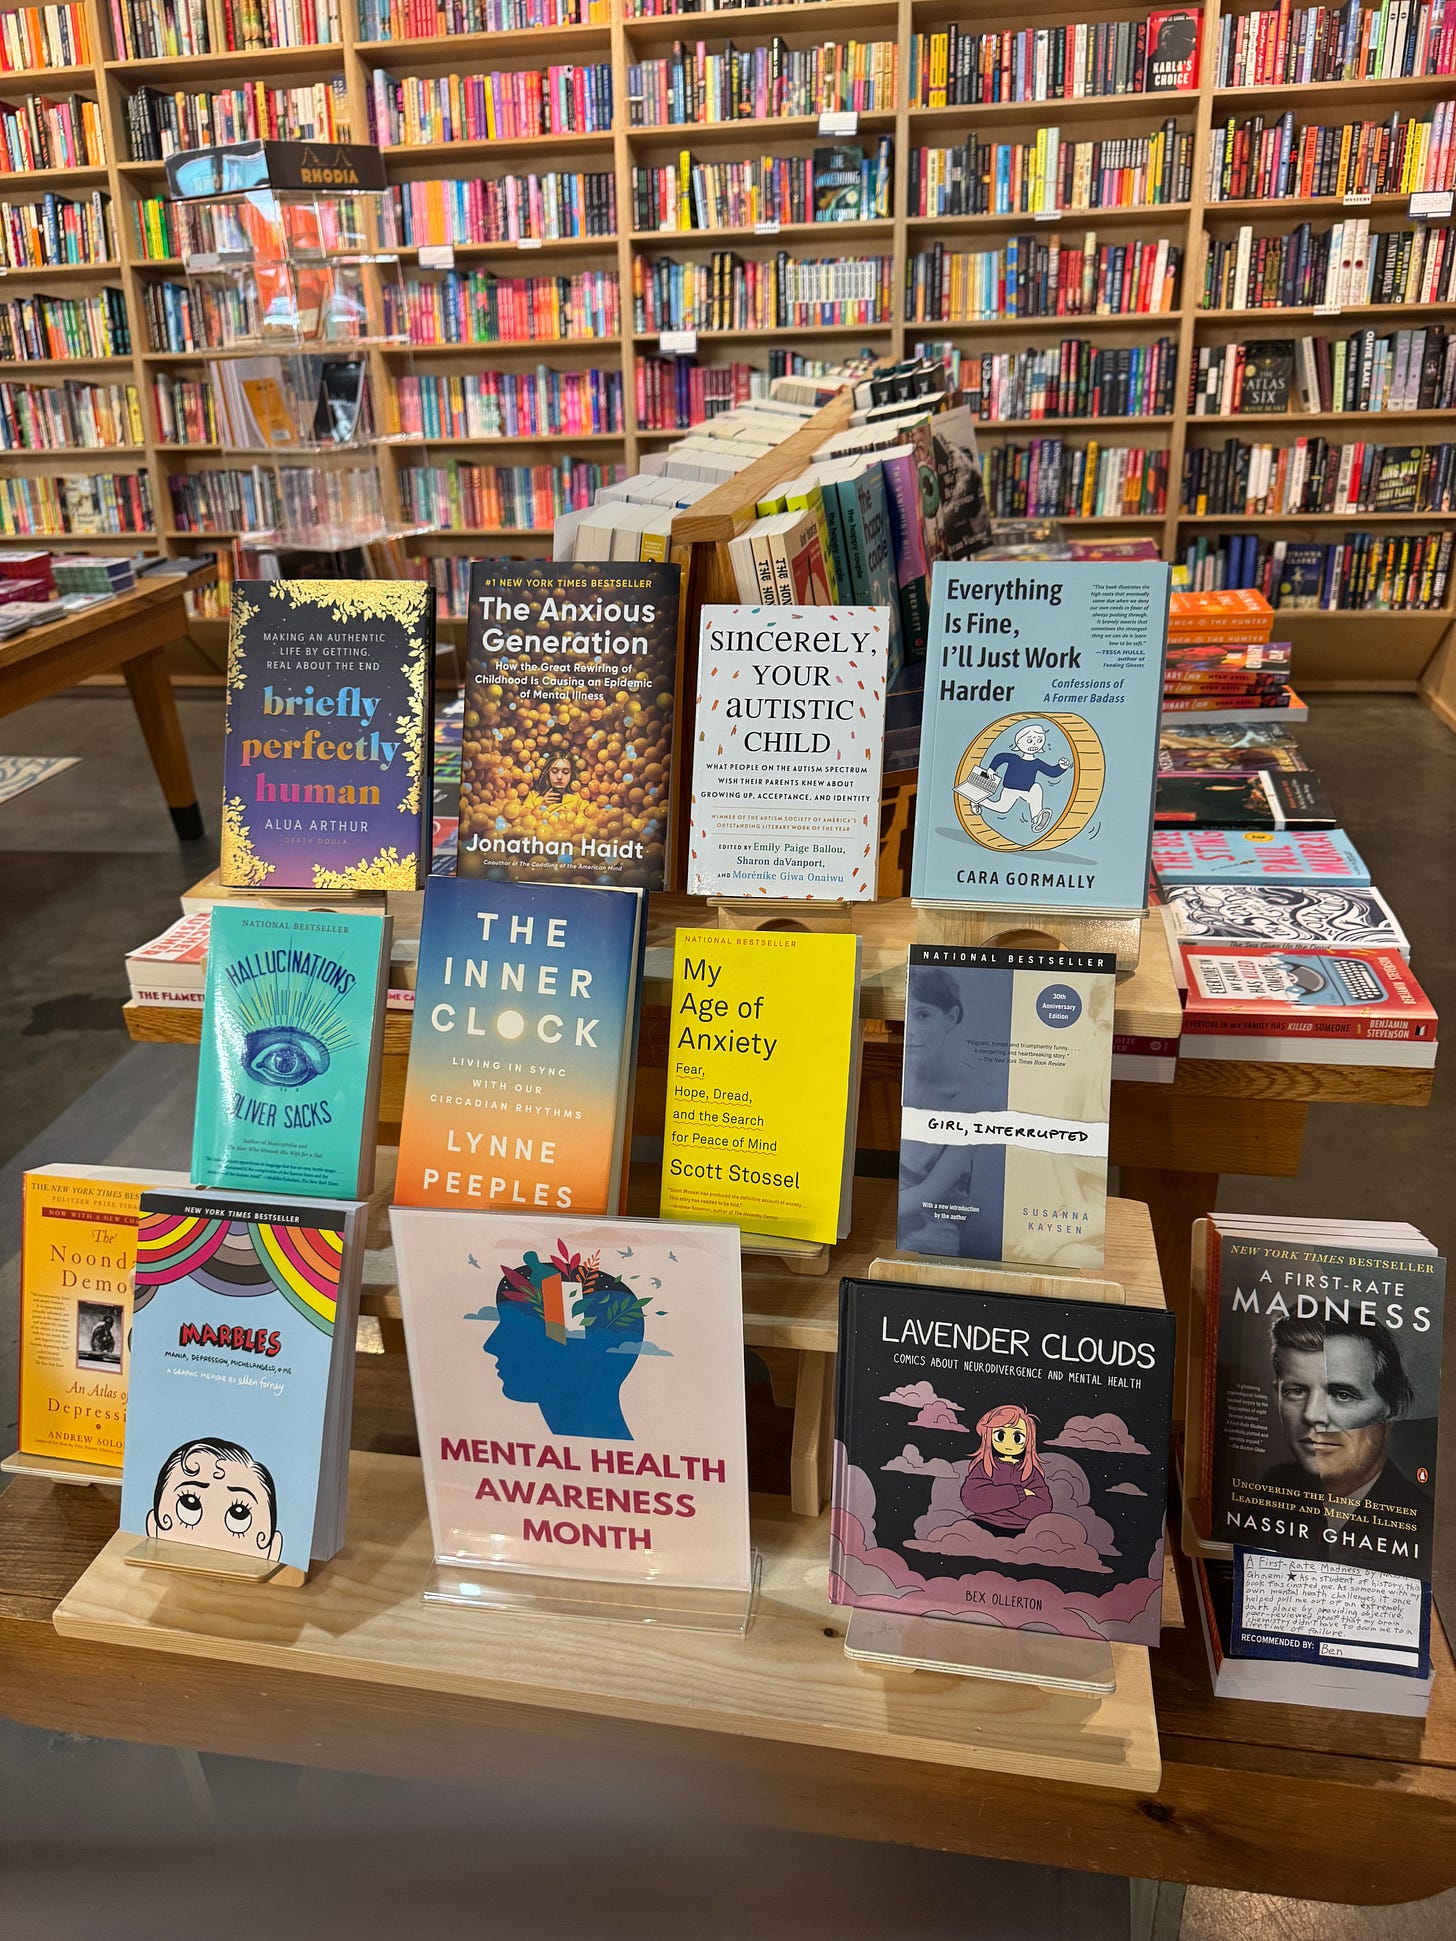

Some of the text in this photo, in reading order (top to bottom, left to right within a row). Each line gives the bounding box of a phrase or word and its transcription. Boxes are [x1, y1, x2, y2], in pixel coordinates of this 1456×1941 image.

[1153, 60, 1192, 74] KARLA'S
[1154, 73, 1189, 86] CHOICE
[300, 168, 359, 184] RHODIA
[1251, 391, 1276, 404] SIX
[486, 579, 496, 587] #1
[499, 579, 522, 587] NEW
[526, 579, 553, 587] YORK
[591, 580, 652, 588] BESTSELLER
[947, 579, 1063, 605] Everything
[479, 597, 656, 623] The Anxious
[945, 613, 1020, 638] Is Fine,
[263, 633, 386, 642] MAKING AN AUTHENTIC
[482, 630, 648, 654] Generation
[280, 647, 302, 656] LIFE
[306, 648, 318, 656] BY
[977, 647, 1019, 668] Just
[1025, 647, 1081, 668] Work
[267, 661, 380, 671] REAL ABOUT THE END
[752, 665, 831, 686] YOUR
[940, 680, 1015, 702] Harder
[1051, 679, 1124, 689] Confessions of
[264, 685, 381, 726] briefly
[1043, 693, 1125, 703] A Former Badass
[241, 729, 400, 770] perfectly
[744, 732, 830, 753] CHILD
[255, 773, 380, 805] human
[265, 819, 368, 832] ALUA ARTHUR
[465, 834, 643, 859] Jonathan Haidt
[753, 842, 781, 853] Emily
[784, 844, 809, 854] Paige
[812, 844, 846, 854] Ballou,
[737, 856, 825, 868] Sharon daVanport,
[732, 870, 777, 880] Morénike
[780, 872, 804, 881] Giwa
[807, 872, 844, 882] Onaiwu
[956, 870, 1095, 889] CARA GORMALLY
[242, 920, 349, 934] NATIONAL BESTSELLER
[477, 912, 567, 948] THE
[923, 951, 1104, 967] NATIONAL BESTSELLER
[226, 950, 357, 994] HALLUCINATIONS
[444, 957, 592, 999] INNER
[683, 958, 722, 987] My
[1042, 1002, 1076, 1012] Anniversary
[1052, 993, 1066, 1001] 30th
[679, 993, 764, 1022] Age of
[1048, 1012, 1069, 1020] Edition
[1271, 1022, 1285, 1030] HAS
[1287, 1023, 1312, 1031] KILLED
[1314, 1023, 1350, 1032] SOMEONE
[1367, 1029, 1409, 1039] STEVENSON
[1370, 1020, 1408, 1029] BENJAMIN
[678, 1027, 777, 1061] Anxiety
[452, 1057, 567, 1077] LIVING IN SYNC
[676, 1063, 705, 1077] Fear,
[472, 1079, 542, 1094] WITH OUR
[675, 1086, 752, 1103] Hope, Dread,
[283, 1100, 332, 1128] SACKS
[430, 1094, 583, 1119] CIRCADIAN RHYTHMS
[673, 1110, 764, 1127] and the Search
[928, 1118, 1089, 1143] GIRL, INTERRUPTED
[447, 1130, 556, 1164] LYNNE
[672, 1131, 777, 1151] for Peace of Mind
[670, 1159, 800, 1189] Scott Stossel
[423, 1169, 573, 1209] PEEPLES
[185, 1206, 300, 1222] NEW YORK TIMES BESTSELLER
[1023, 1207, 1089, 1221] SUSANNA
[92, 1230, 117, 1245] The
[1028, 1222, 1083, 1234] KAYSEN
[1230, 1245, 1434, 1273] NEW YORK TIMES BESTSELLER
[1259, 1270, 1405, 1297] A FIRST-RATE
[1232, 1286, 1432, 1333] MADNESS
[180, 1323, 282, 1358] MARBLES
[881, 1316, 1155, 1369] LAVENDER CLOUDS
[894, 1354, 1142, 1389] COMICS ABOUT NEURODIVERGENCE AND MENTAL HEALTH
[48, 1431, 93, 1443] ANDREW
[97, 1436, 125, 1448] SOLO
[440, 1437, 726, 1483] MENTAL HEALTH
[475, 1478, 696, 1518] AWARENESS
[522, 1519, 652, 1550] MONTH
[1227, 1511, 1419, 1559] NASSIR GHAEMI
[965, 1590, 1042, 1610] BEX OLLERTON
[1241, 1633, 1315, 1650] RECOMMENDED BY:
[1321, 1644, 1343, 1656] Ben
